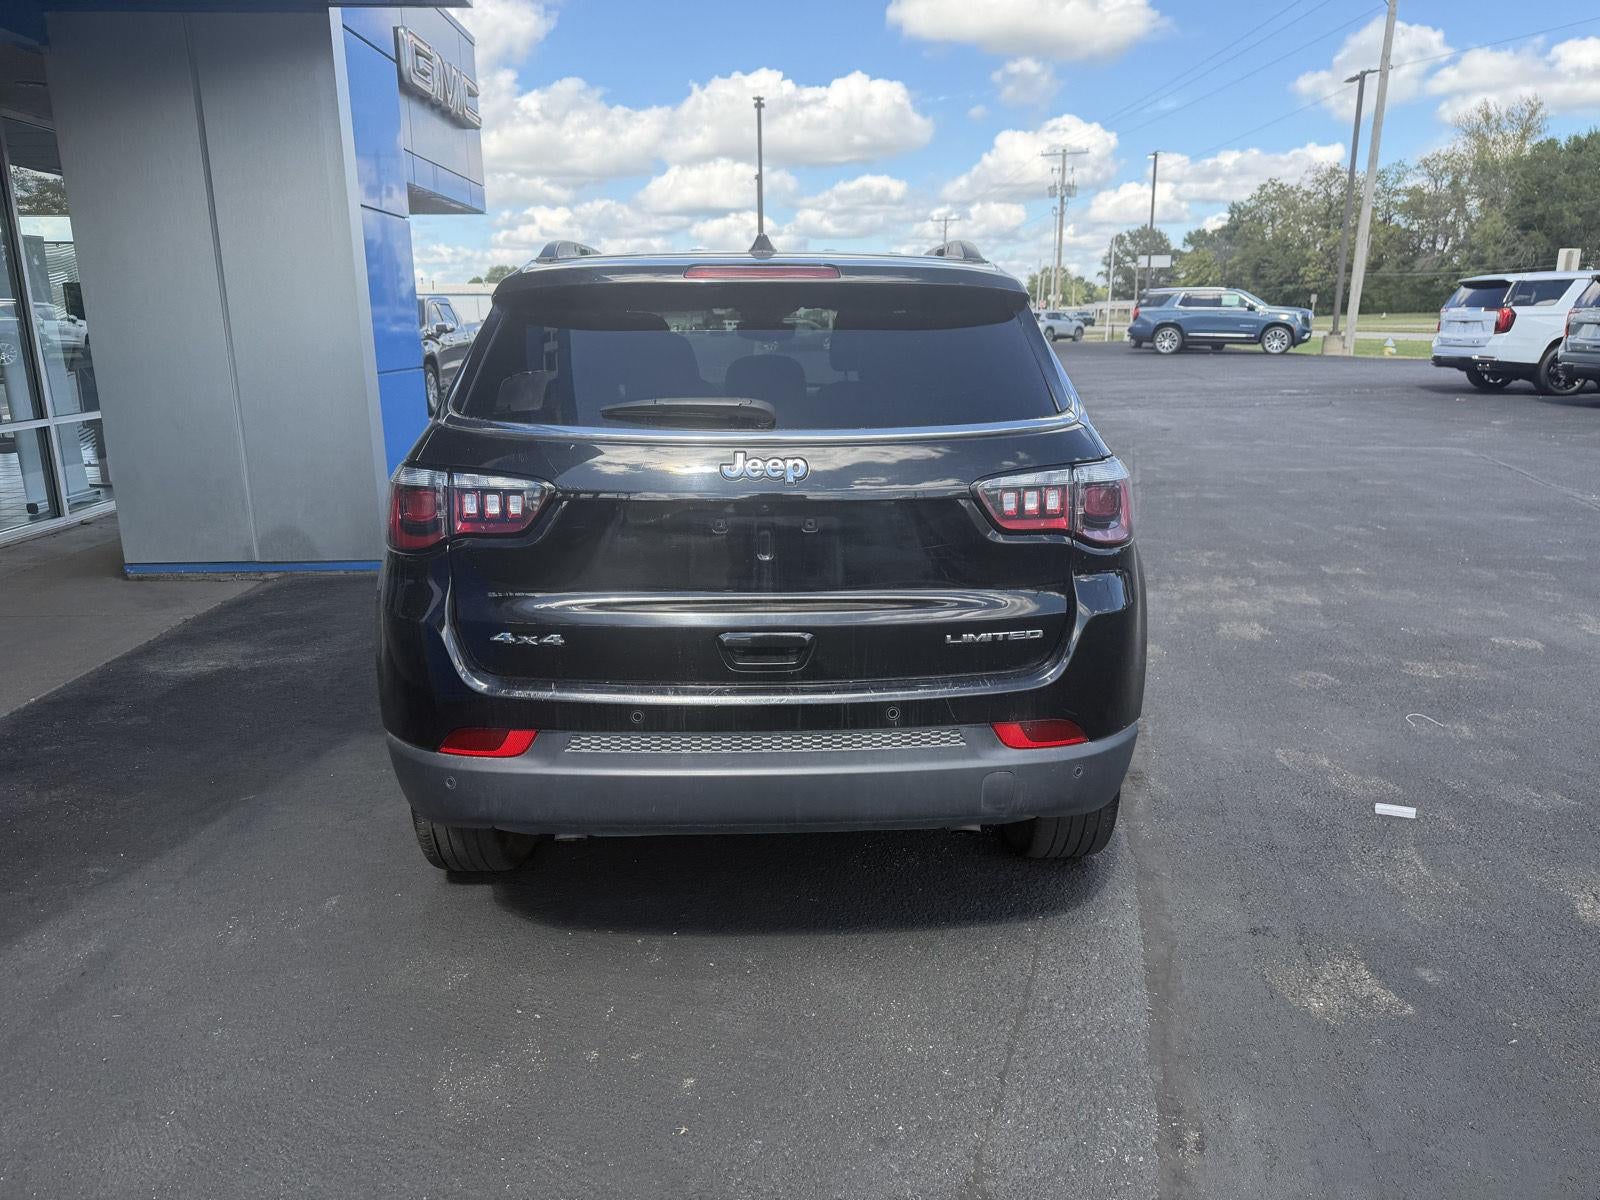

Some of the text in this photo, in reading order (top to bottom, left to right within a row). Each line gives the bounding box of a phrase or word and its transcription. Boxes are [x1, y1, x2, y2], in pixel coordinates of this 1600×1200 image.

[397, 27, 481, 129] GMC
[721, 451, 808, 485] Jeep
[945, 629, 1043, 644] LIMITED
